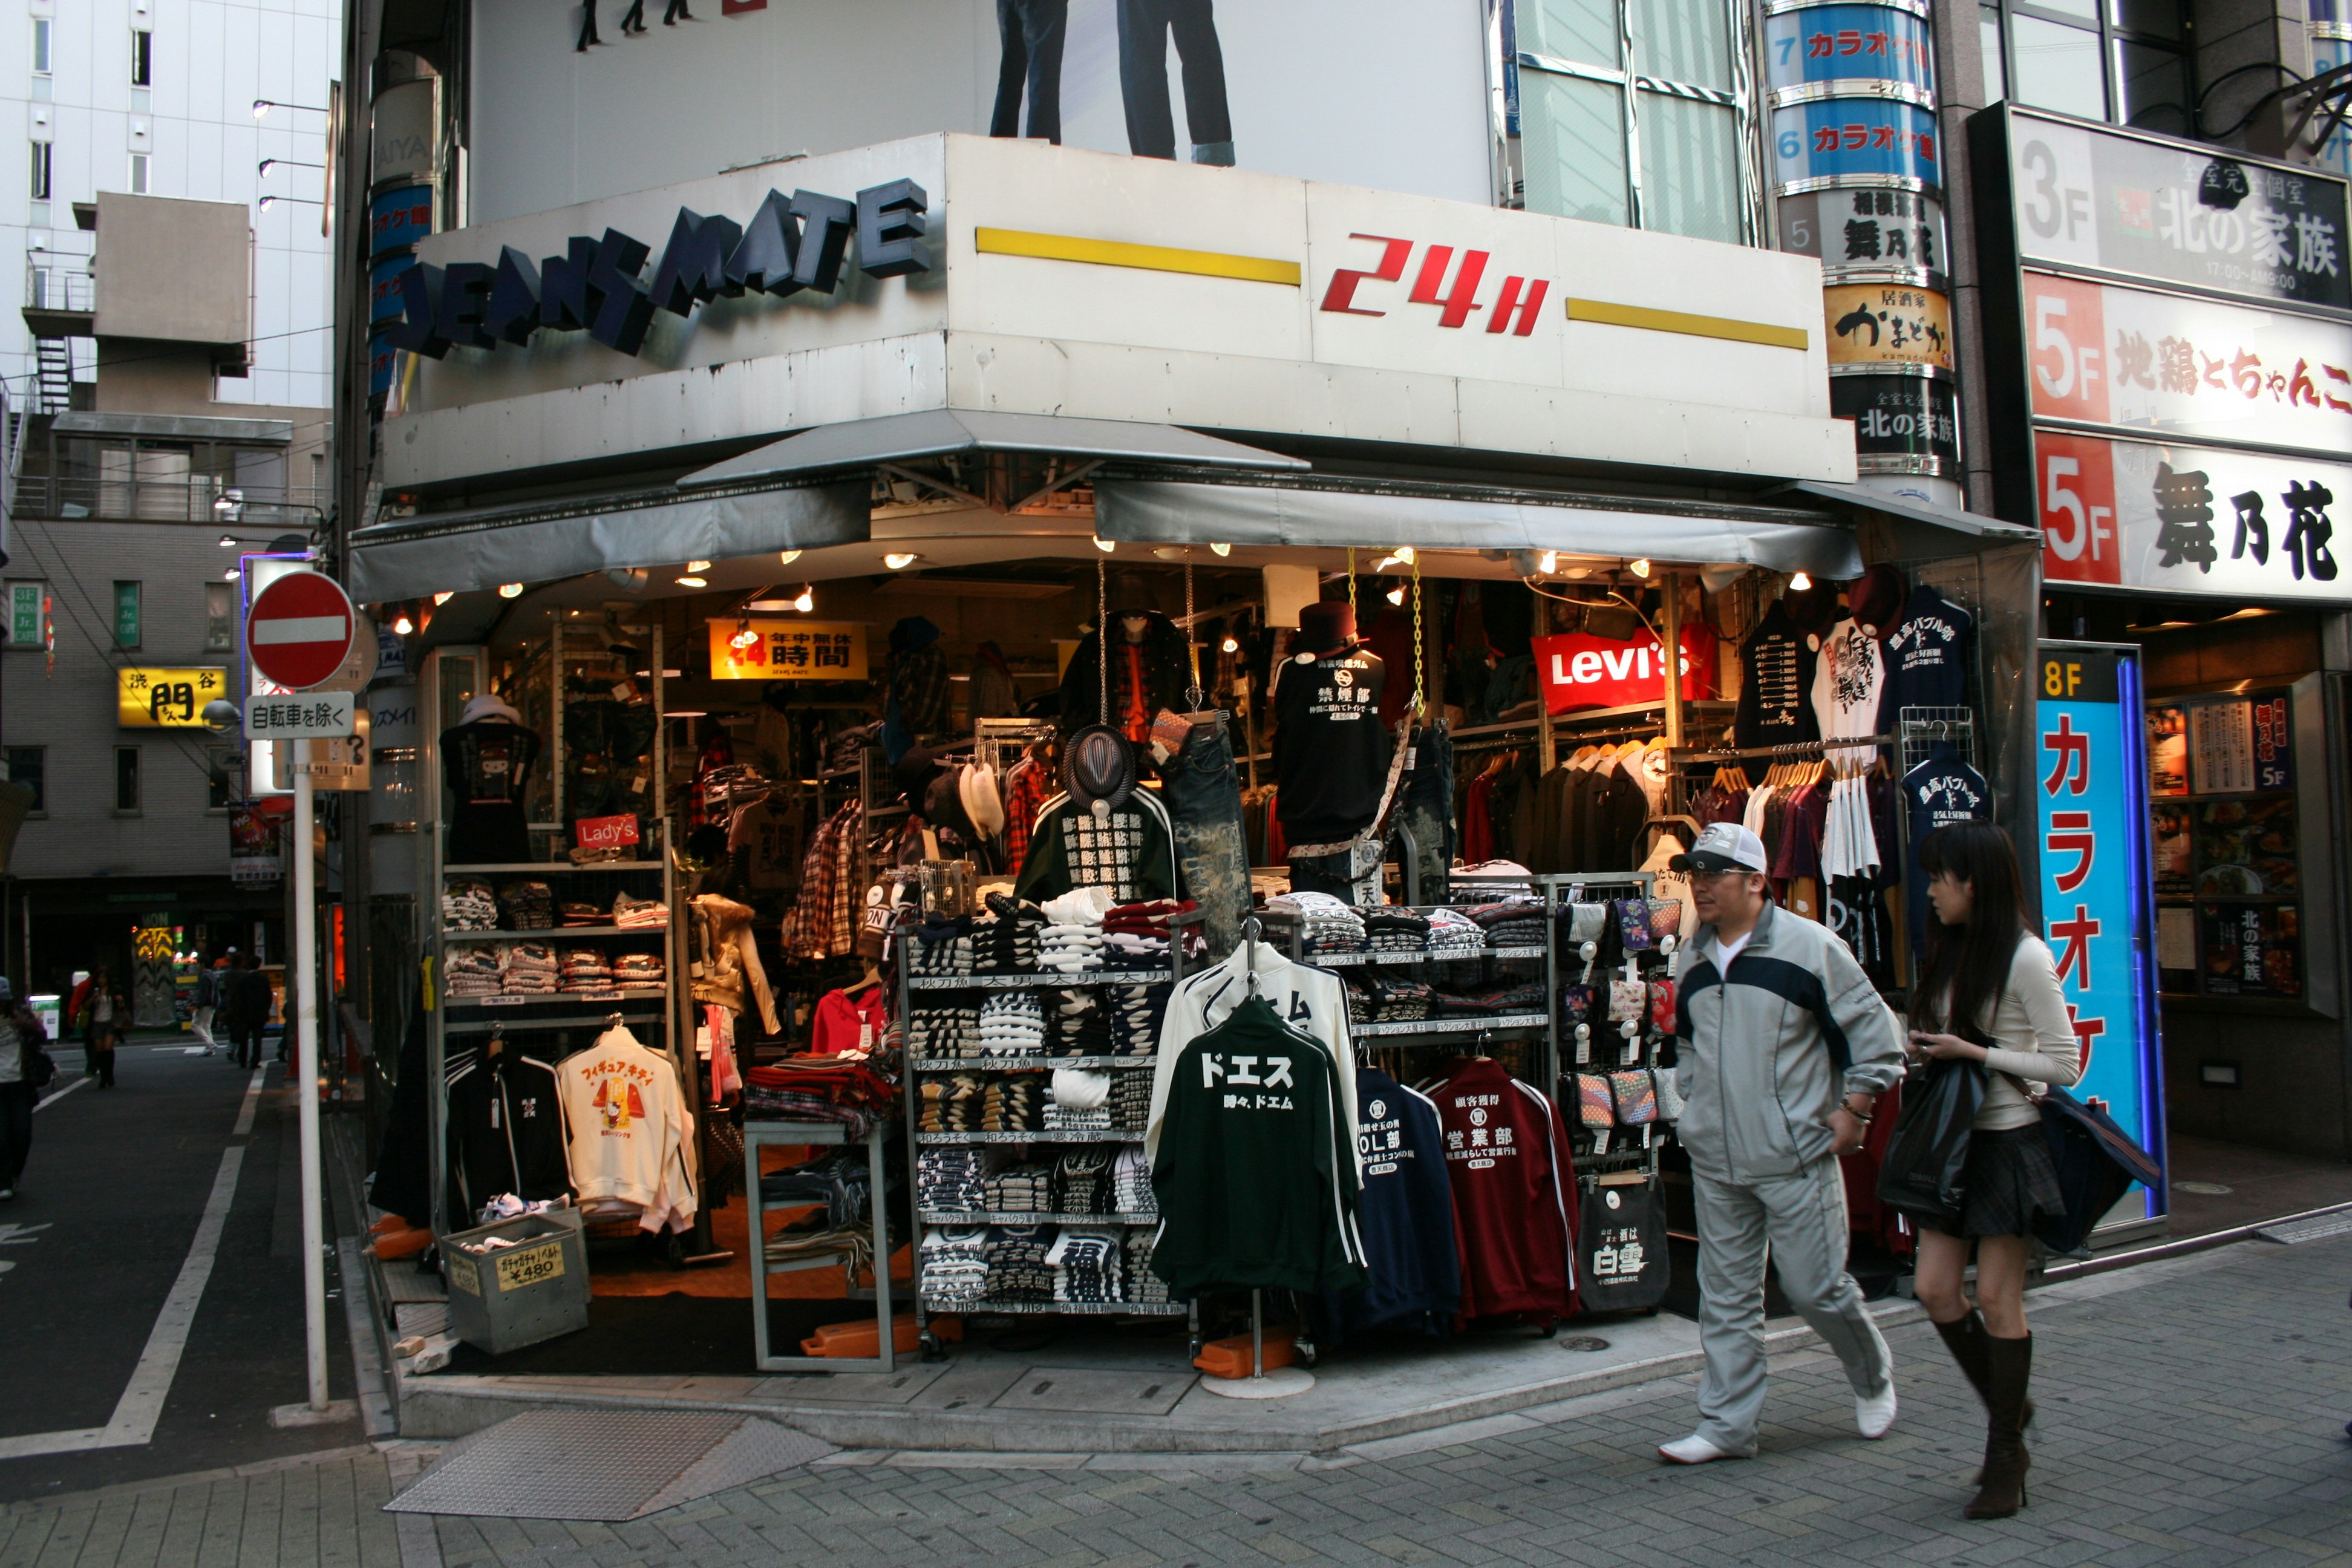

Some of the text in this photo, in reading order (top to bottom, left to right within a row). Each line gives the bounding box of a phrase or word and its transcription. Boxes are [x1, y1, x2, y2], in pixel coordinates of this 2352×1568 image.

[1775, 36, 1795, 66] 7
[375, 134, 429, 168] AIYA
[1777, 131, 1801, 158] 6
[2022, 139, 2089, 241] 3F
[1791, 220, 1810, 249] 5
[2159, 186, 2339, 279] 北の家族
[383, 178, 930, 361] JEANS MATE
[1320, 232, 1550, 336] 24H
[2034, 295, 2100, 400] 5F
[1860, 409, 1955, 445] 北の家族
[2047, 455, 2111, 562] 5F
[2152, 461, 2337, 581] 舞乃花
[771, 632, 853, 645] 年中無休
[772, 645, 851, 668] 時間
[2044, 661, 2082, 697] 8F
[252, 702, 344, 729] 自転車を除く
[2262, 766, 2285, 786] 5F
[583, 823, 635, 842] Lady's
[2042, 713, 2109, 1113] カラオケ
[2241, 910, 2261, 982] 北の家族
[1201, 1052, 1294, 1089] ドエス
[1455, 1094, 1500, 1108] 顧客獲得
[920, 1131, 1103, 1144] 和ろうそく 和ろうそく 要冷蔵
[1593, 1241, 1650, 1275] 白雪
